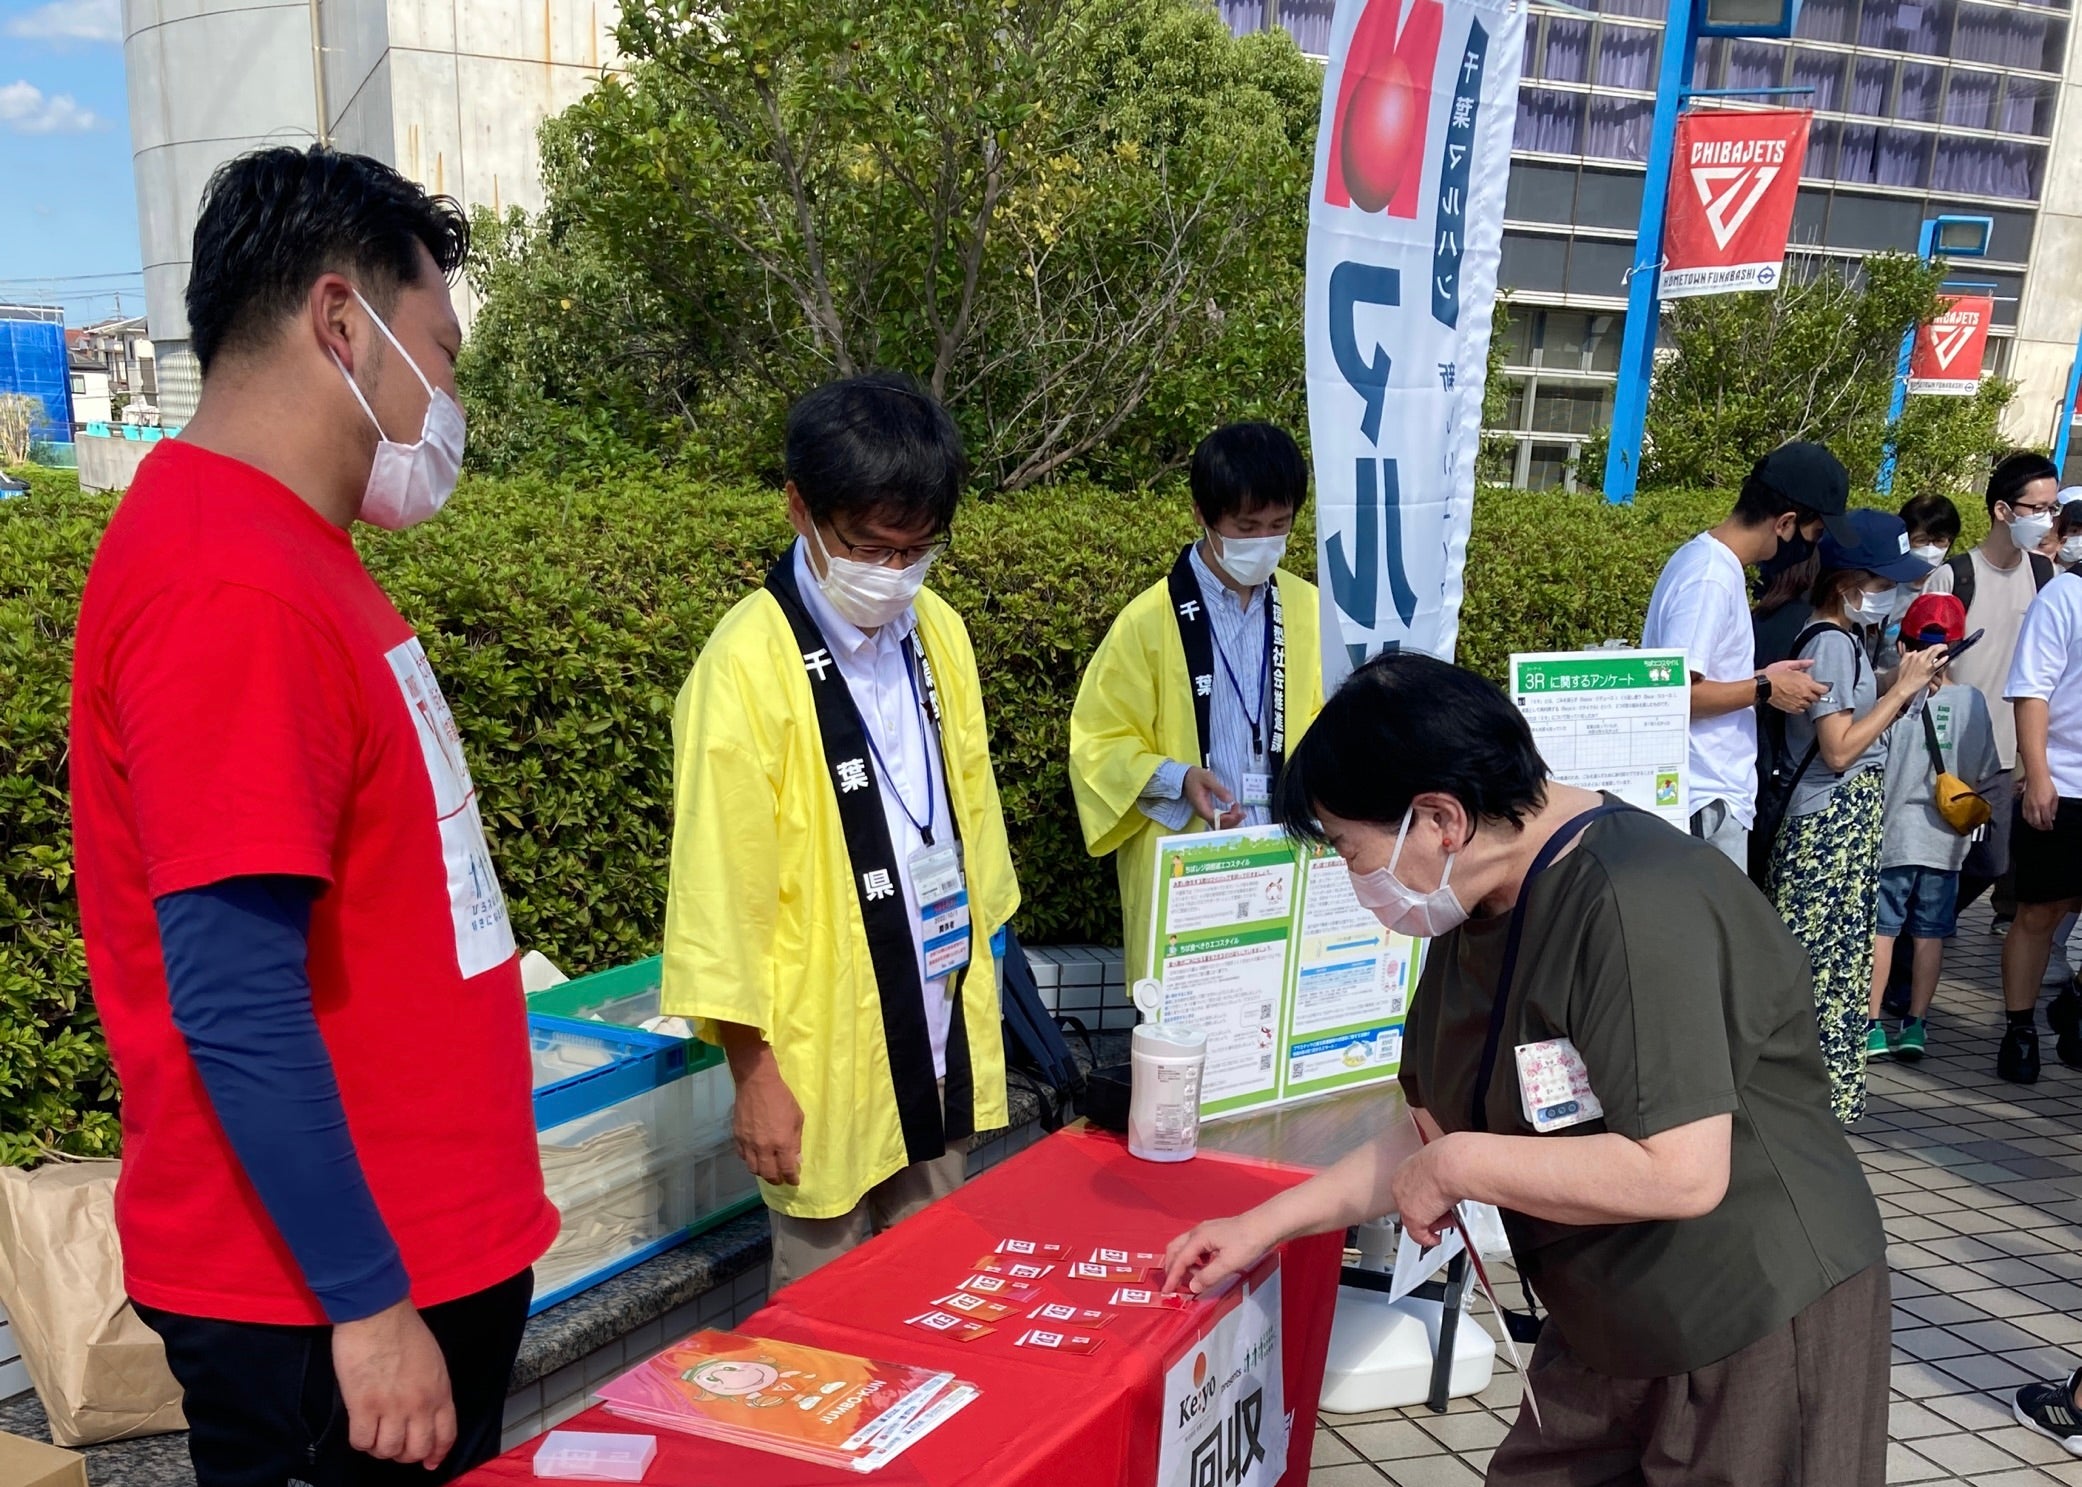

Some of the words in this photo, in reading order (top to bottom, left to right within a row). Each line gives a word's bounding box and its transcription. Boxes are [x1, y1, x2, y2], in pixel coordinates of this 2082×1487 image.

[1663, 272, 1707, 288] HOMETOWN
[1707, 268, 1756, 284] FUNABASHI
[1525, 672, 1545, 690] 3R
[1550, 672, 1635, 689] に関するアンケート
[803, 647, 896, 901] 千葉県
[819, 1379, 888, 1425] JUMBO-KUN
[1189, 1386, 1266, 1487] 回収
